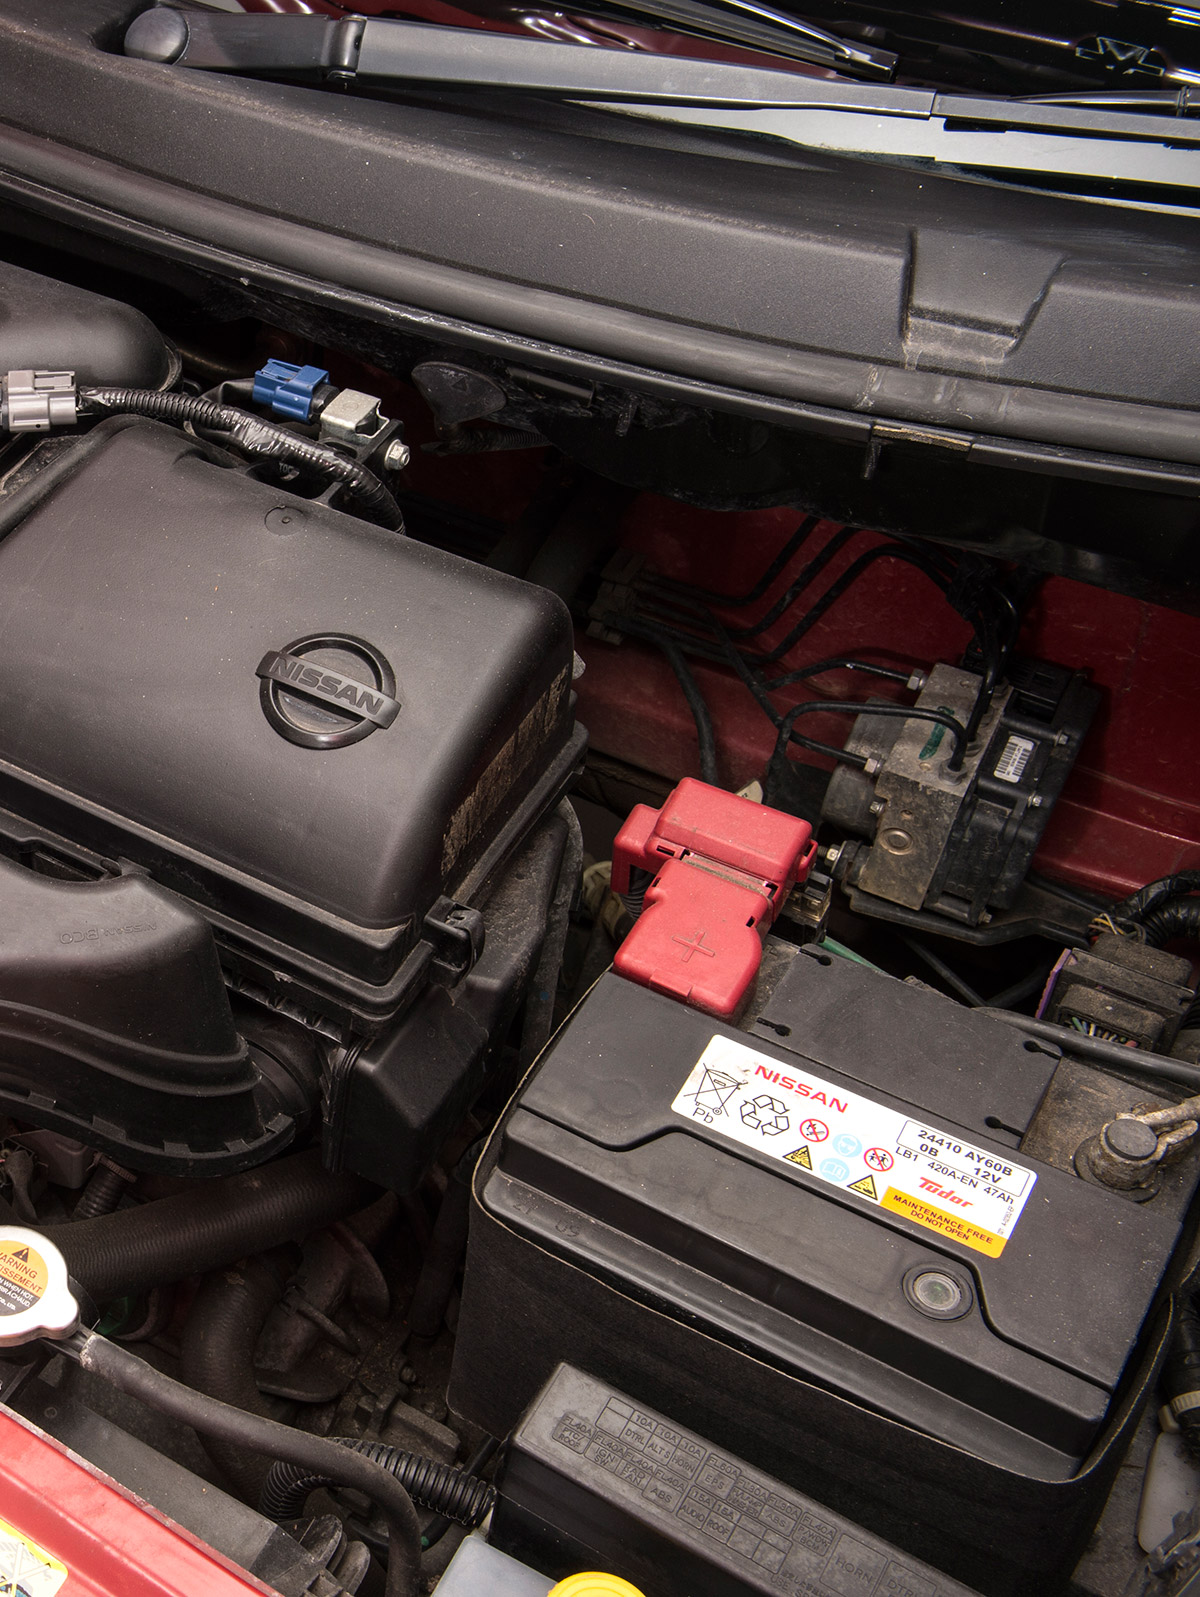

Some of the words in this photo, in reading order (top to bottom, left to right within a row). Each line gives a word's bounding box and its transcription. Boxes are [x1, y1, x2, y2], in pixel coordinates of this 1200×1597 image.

[269, 657, 384, 716] NISSAN
[104, 922, 157, 936] NISSAN
[754, 1065, 848, 1114] NISSAN
[692, 1107, 714, 1123] Pb
[918, 1130, 963, 1154] 24410
[965, 1152, 1013, 1176] AY60B
[919, 1143, 939, 1157] 0B
[973, 1167, 1002, 1184] 12V
[896, 1147, 918, 1162] LB1
[927, 1161, 979, 1188] 420A-EN
[984, 1187, 1014, 1205] 47Ah
[918, 1176, 974, 1208] Tudor
[893, 1194, 964, 1231] MAINTENANCE
[966, 1228, 993, 1244] FREE
[911, 1209, 925, 1220] DO
[925, 1217, 942, 1229] NOT
[945, 1225, 970, 1241] OPEN
[3, 1280, 20, 1293] WHEN
[562, 1416, 592, 1437] FL40A
[635, 1414, 652, 1430] 10A
[558, 1434, 581, 1449] ROOF
[625, 1429, 644, 1445] DTRL
[659, 1428, 677, 1444] 10A
[595, 1434, 624, 1457] FL40A
[647, 1442, 663, 1455] ALT
[684, 1442, 701, 1457] 10A
[594, 1454, 607, 1466] SW
[596, 1447, 615, 1462] IGN
[625, 1451, 656, 1474] FL40A
[623, 1463, 646, 1479] RAD
[672, 1453, 696, 1473] HORN
[620, 1469, 642, 1486] FAN
[655, 1469, 685, 1492] FL40A
[705, 1474, 724, 1490] EPS
[650, 1488, 672, 1503] ABS
[680, 1504, 706, 1523] AUDIO
[766, 1513, 786, 1528] ABS
[706, 1520, 730, 1536] ROOF
[803, 1516, 834, 1540] FL40A
[800, 1536, 820, 1550] BCM
[835, 1557, 873, 1584] HORN
[771, 1574, 789, 1590] USE
